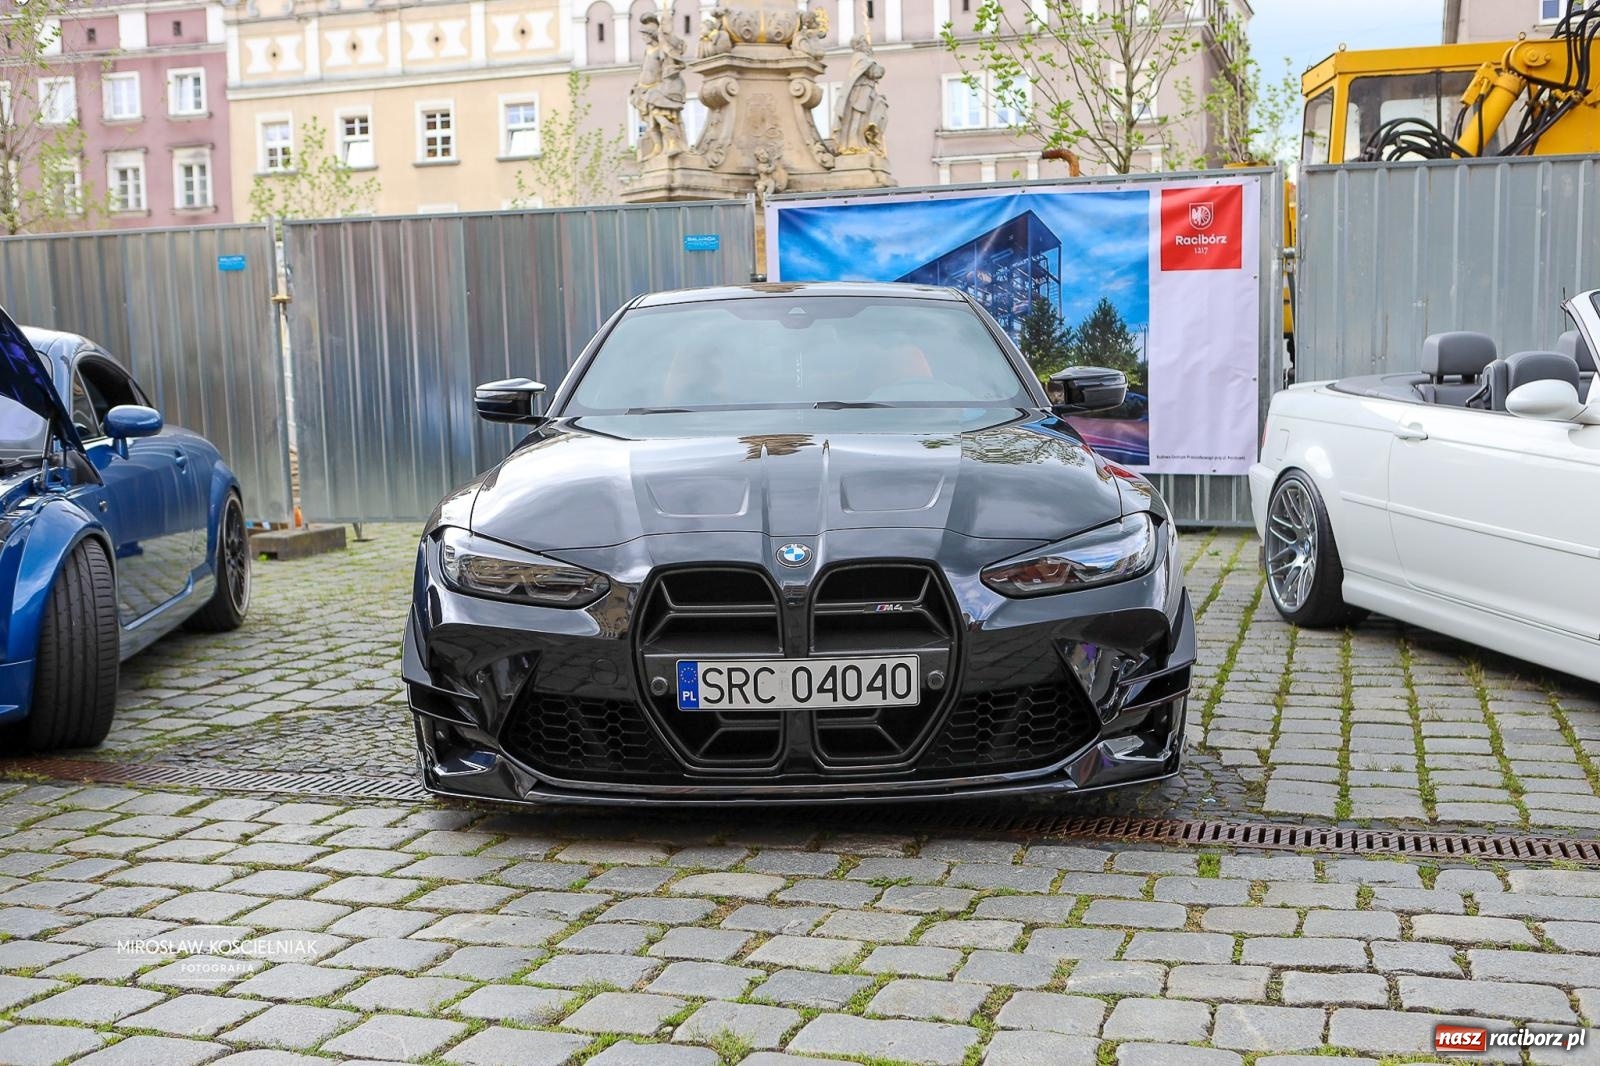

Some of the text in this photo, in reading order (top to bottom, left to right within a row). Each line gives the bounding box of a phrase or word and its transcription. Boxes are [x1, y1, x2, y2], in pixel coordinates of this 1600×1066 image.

[1175, 233, 1227, 245] Racibórz
[1194, 247, 1208, 255] 1217
[702, 662, 912, 704] SRC 04040
[682, 690, 697, 701] PL
